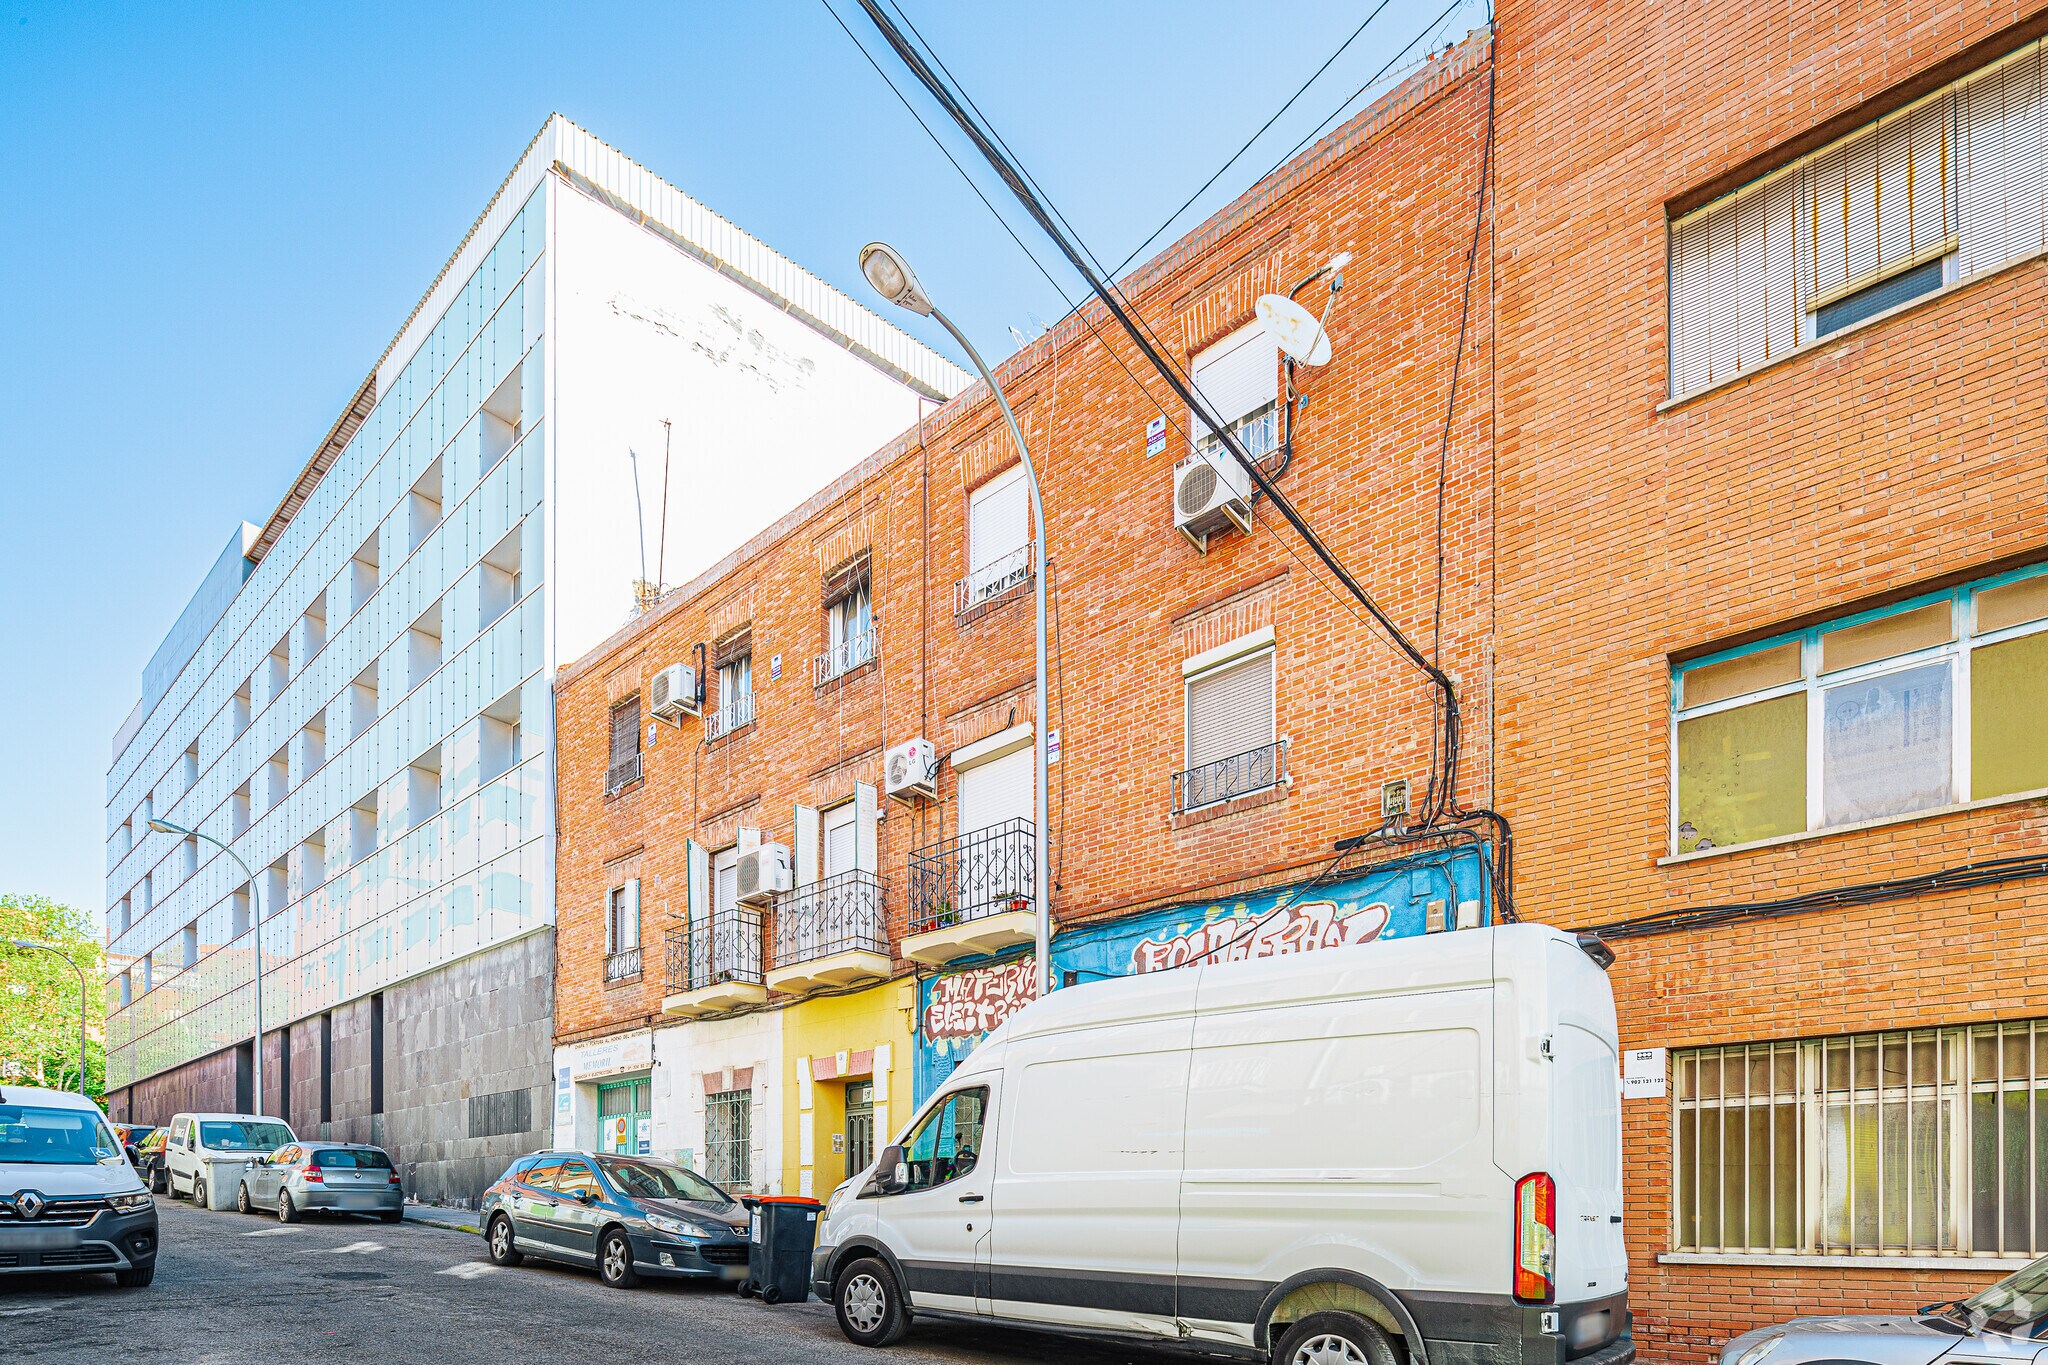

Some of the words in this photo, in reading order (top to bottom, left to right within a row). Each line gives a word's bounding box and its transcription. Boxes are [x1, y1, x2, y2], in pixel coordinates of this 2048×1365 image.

[909, 758, 916, 766] LG
[940, 955, 1056, 1003] MATERIA
[580, 1044, 619, 1058] TALLERES
